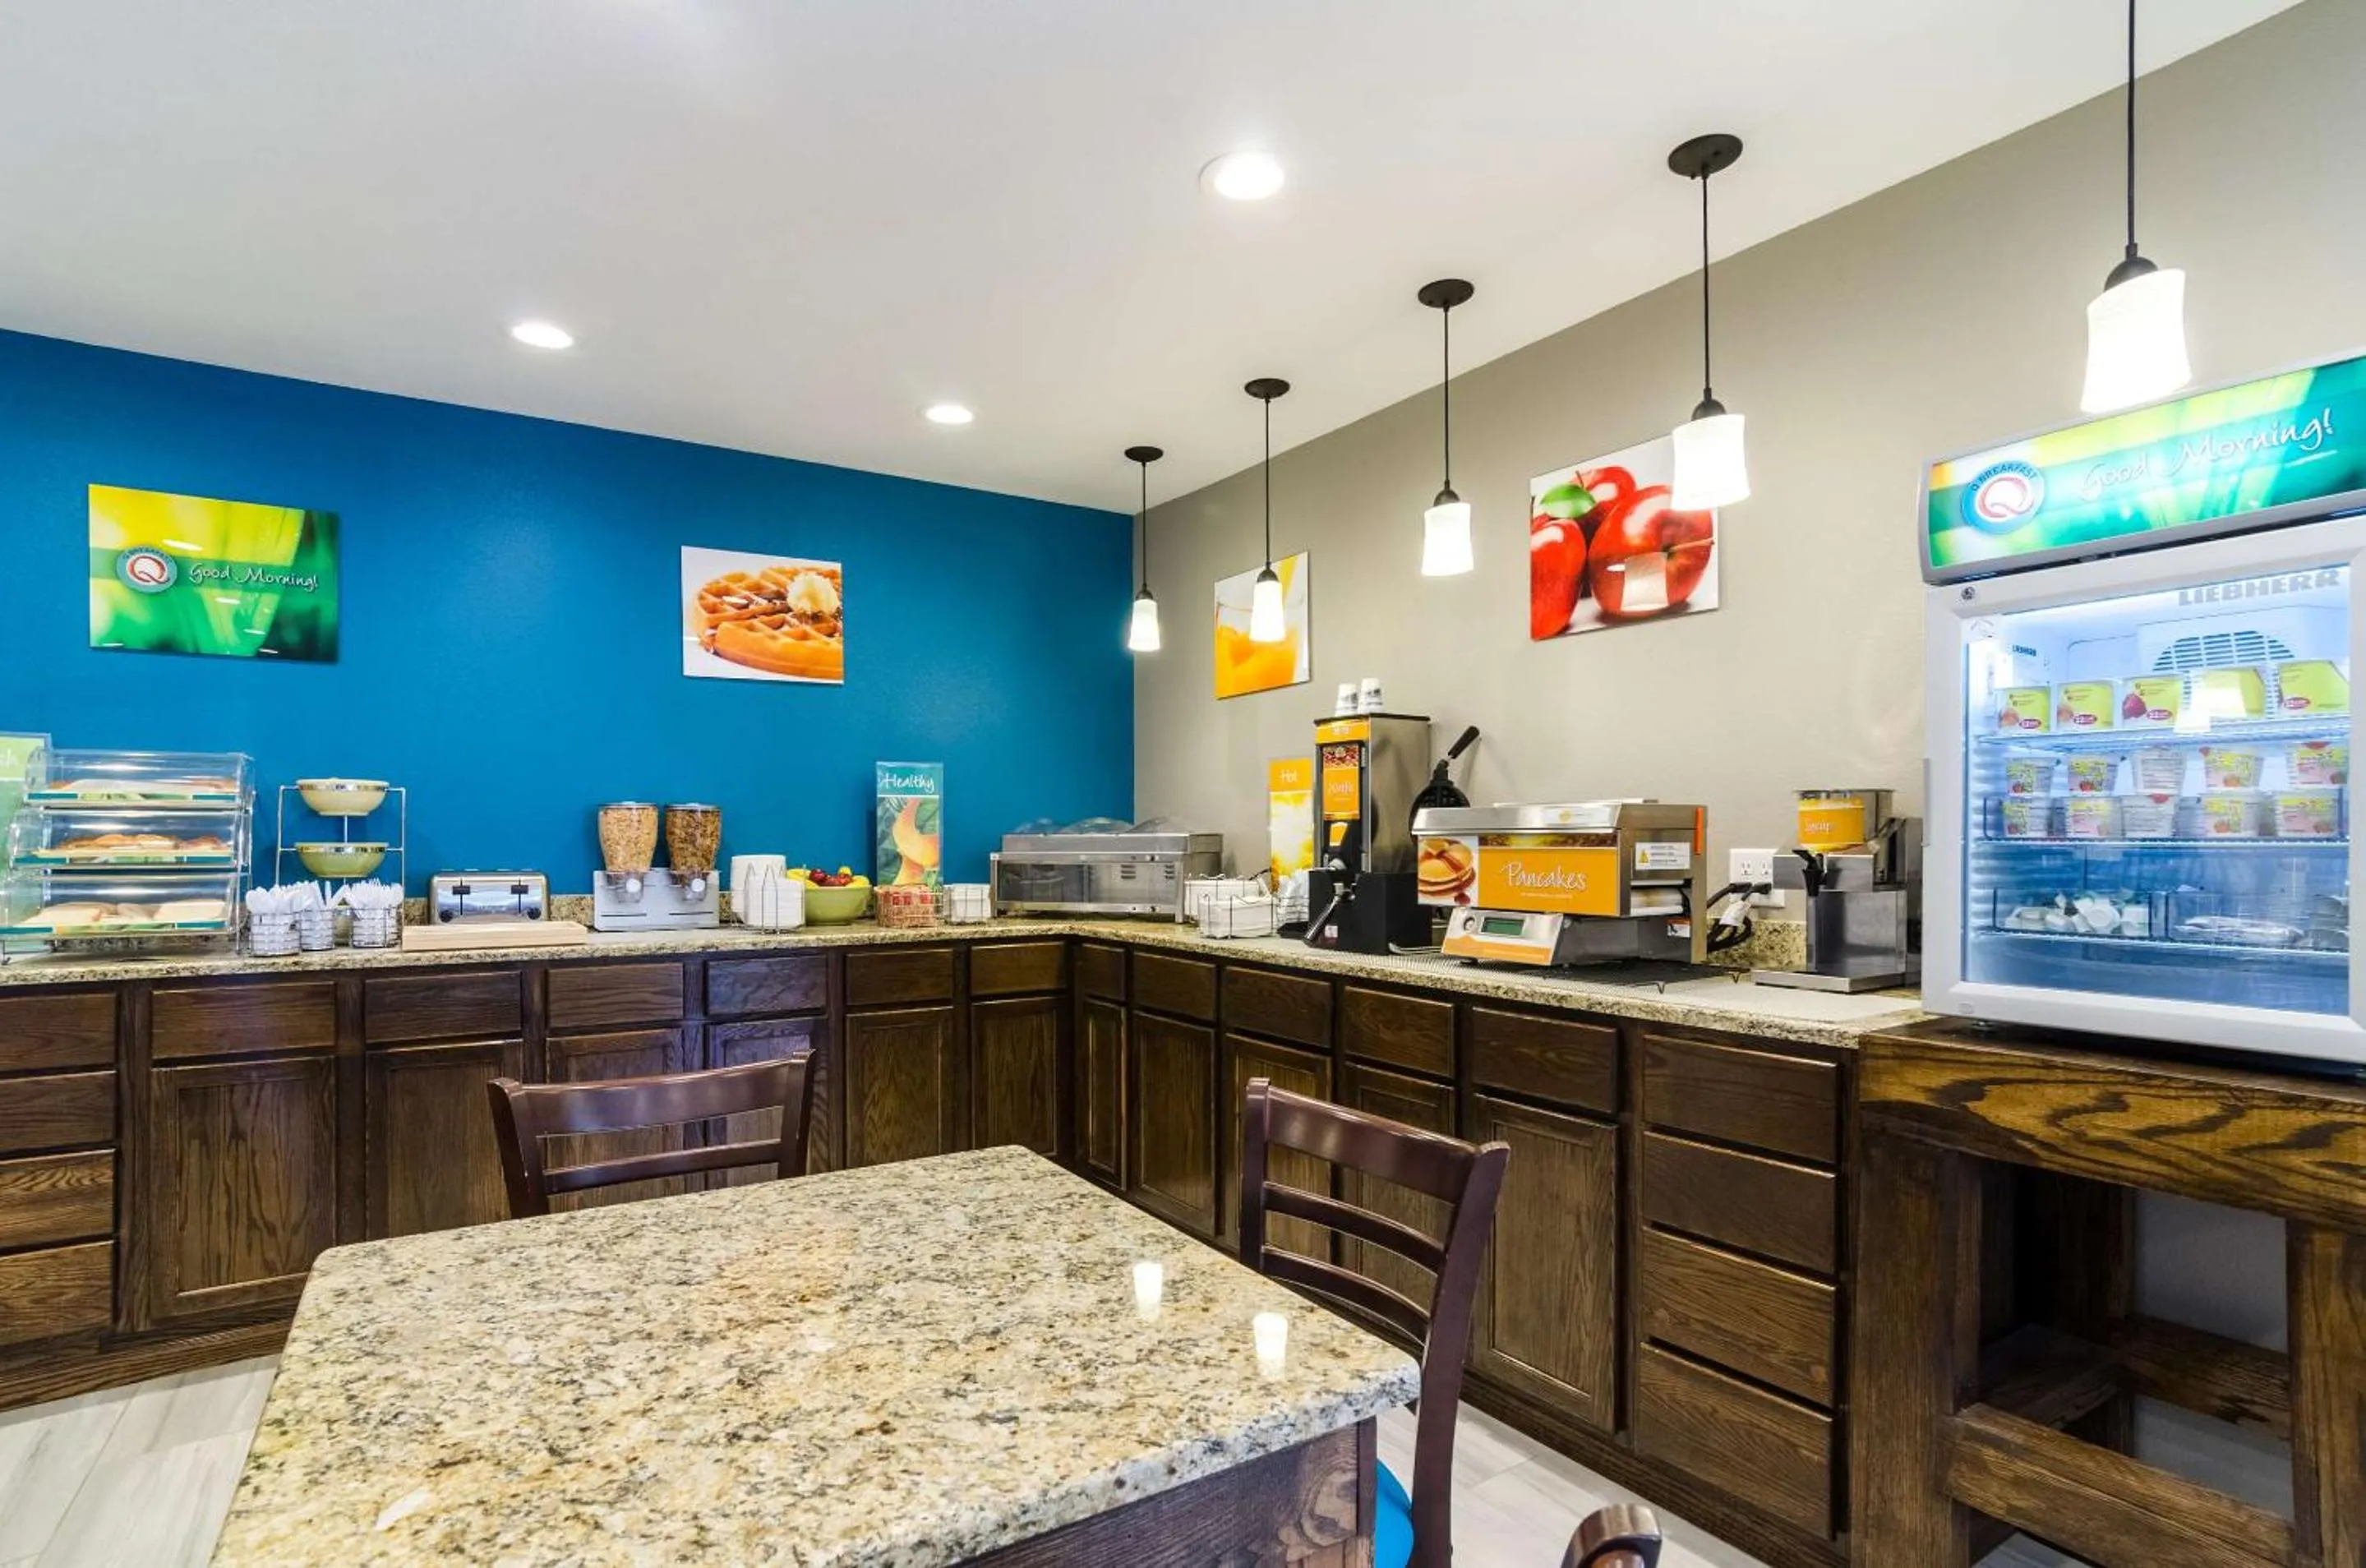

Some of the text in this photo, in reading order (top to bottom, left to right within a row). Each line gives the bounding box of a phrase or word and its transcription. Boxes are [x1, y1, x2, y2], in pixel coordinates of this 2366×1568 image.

[2081, 408, 2334, 500] Good Morning!
[1976, 463, 2040, 482] BREAKFAST
[189, 563, 318, 593] Good Morning!
[2179, 570, 2340, 606] LIEBHERR
[880, 772, 934, 794] Healthy
[1500, 861, 1588, 892] Pancakes
